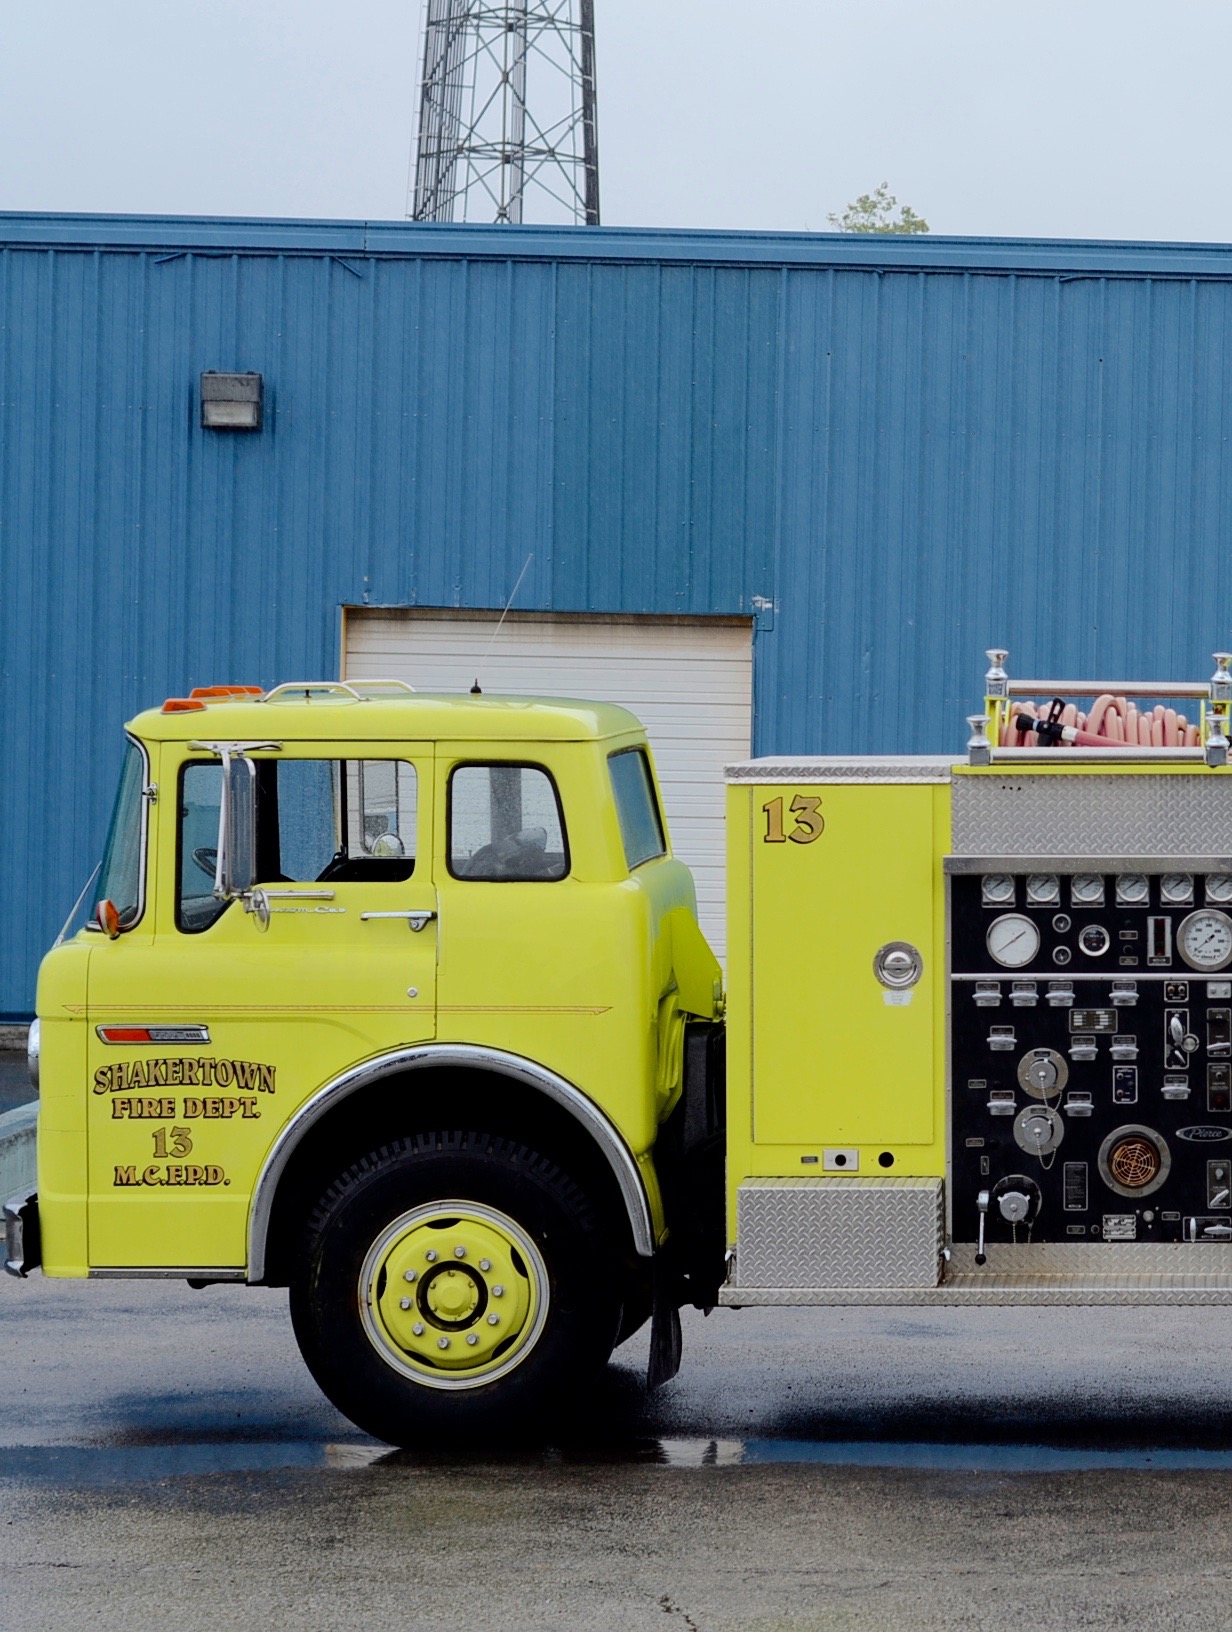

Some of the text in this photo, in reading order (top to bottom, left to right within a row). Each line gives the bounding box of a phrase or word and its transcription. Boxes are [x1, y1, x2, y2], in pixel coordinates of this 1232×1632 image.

[763, 794, 824, 844] 13
[93, 1057, 276, 1095] SHAKERTOWN
[112, 1097, 261, 1119] FIRE DEPT.
[152, 1126, 194, 1158] 13
[1189, 1128, 1223, 1139] Pierce
[113, 1165, 231, 1187] M.C.F.P.D.
